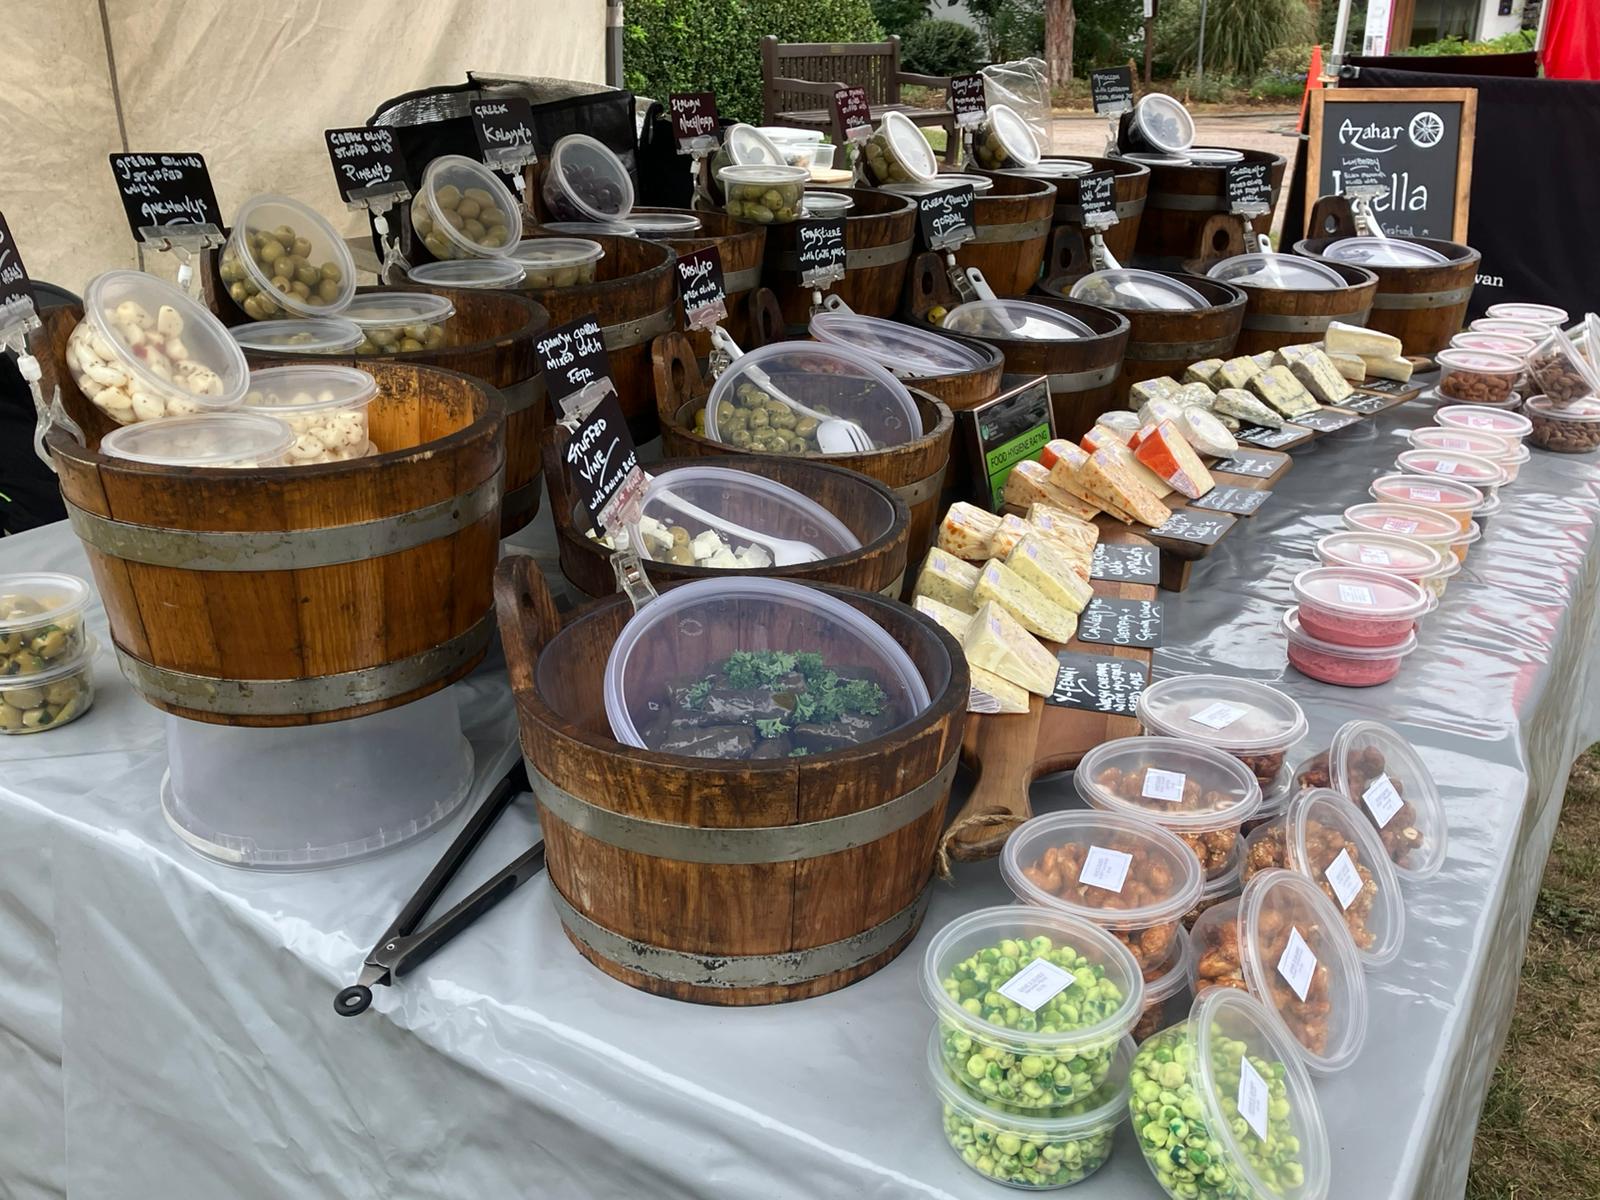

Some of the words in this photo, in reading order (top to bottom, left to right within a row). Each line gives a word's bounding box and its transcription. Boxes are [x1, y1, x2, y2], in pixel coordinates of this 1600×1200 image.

[475, 104, 509, 119] GREEK
[1339, 118, 1404, 153] Azahar
[1332, 170, 1427, 212] ella
[567, 419, 607, 465] STUFFED
[990, 451, 1008, 468] FOOD
[1007, 439, 1031, 457] HYGIENE
[1029, 430, 1048, 448] RATING
[580, 450, 607, 484] VINE
